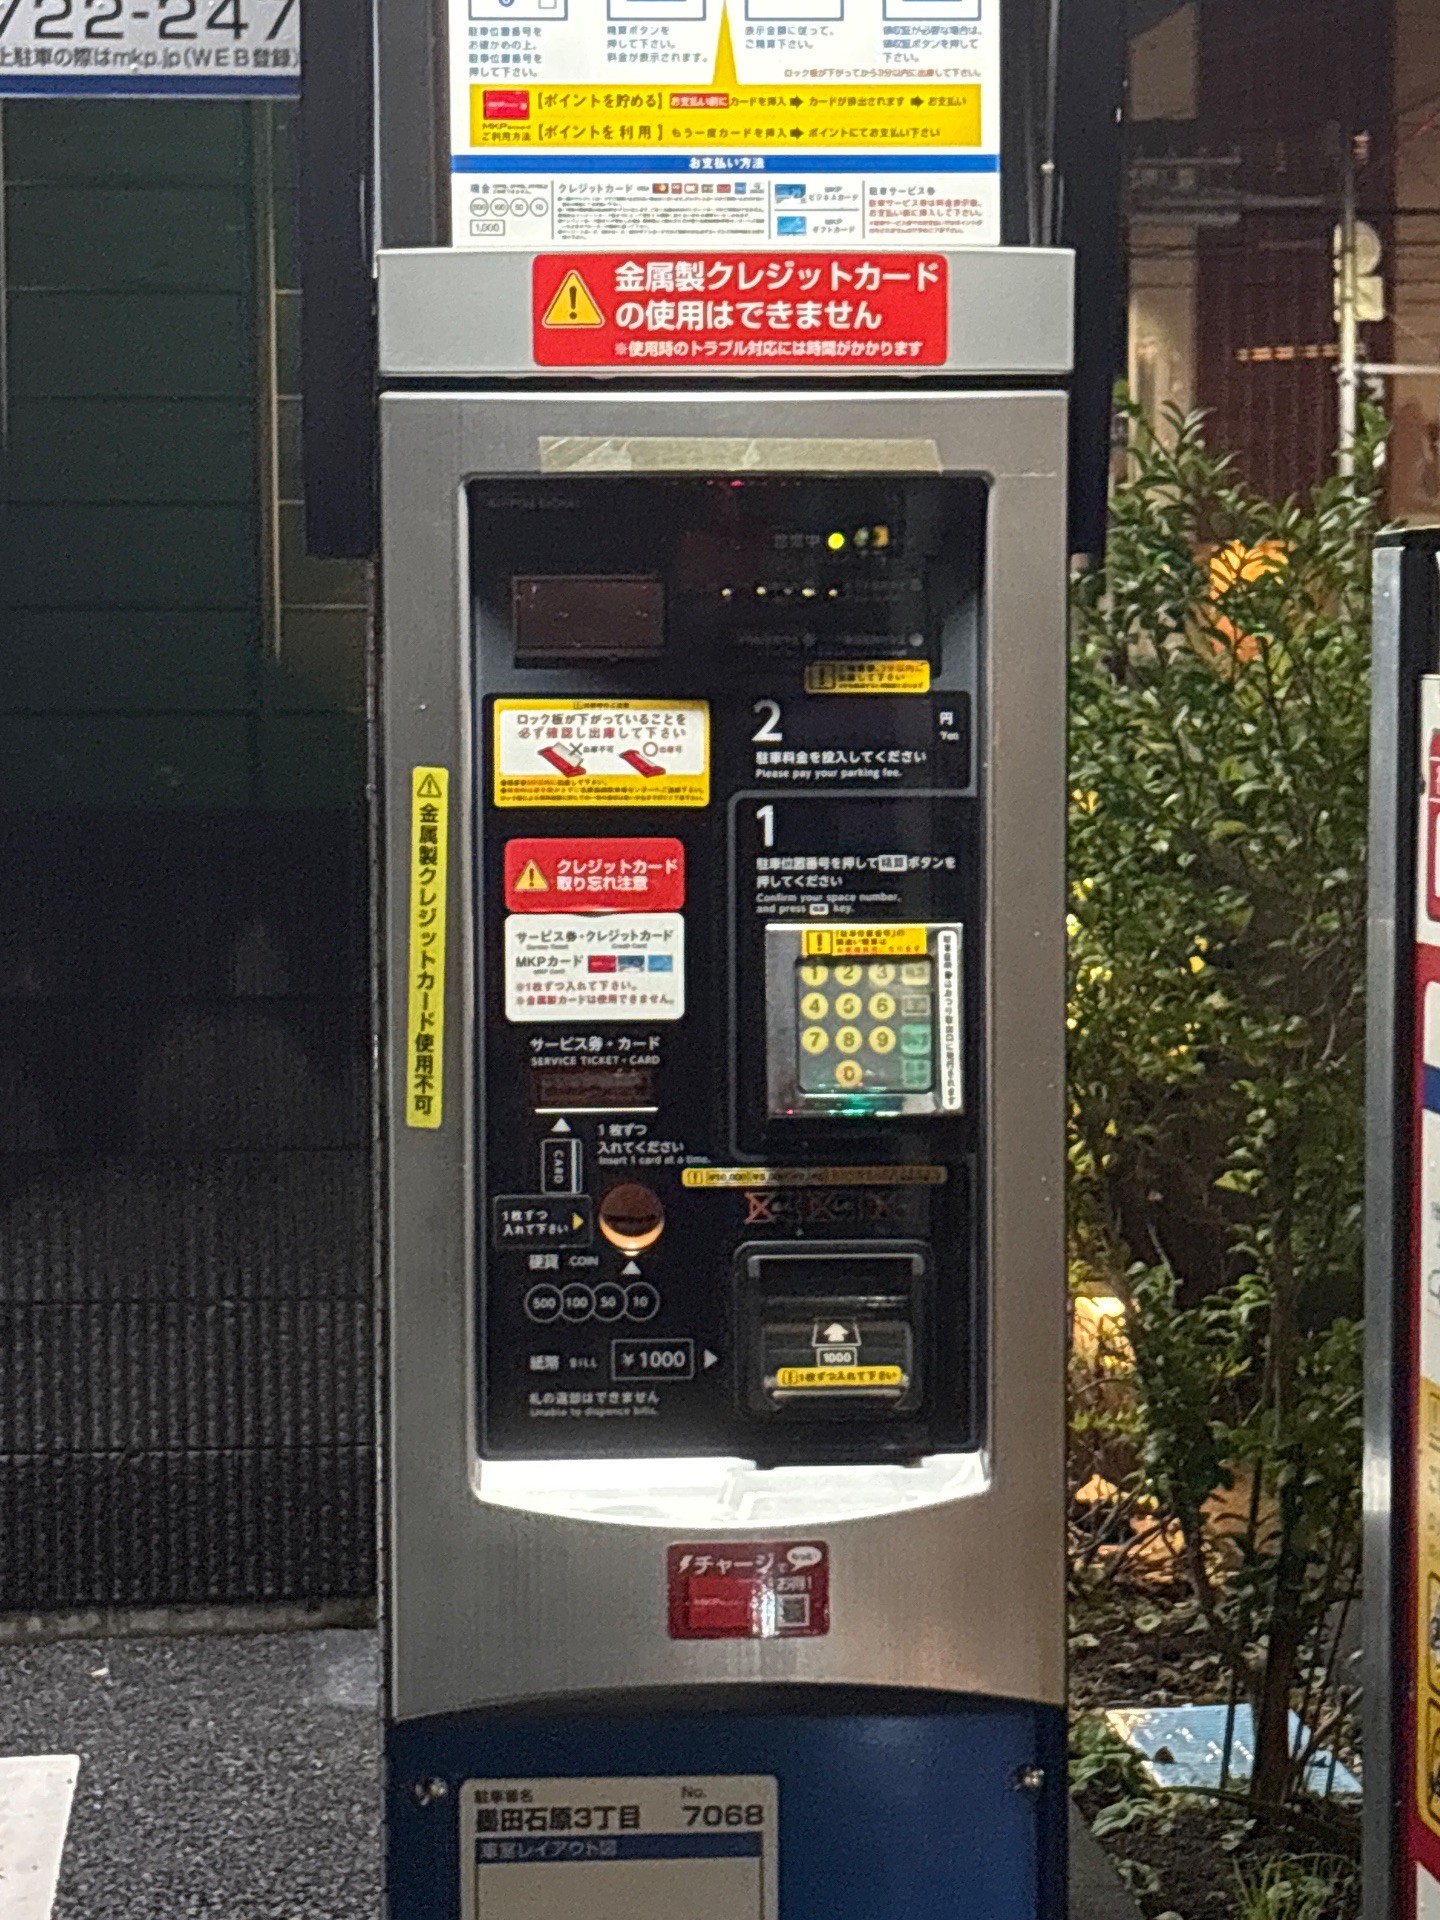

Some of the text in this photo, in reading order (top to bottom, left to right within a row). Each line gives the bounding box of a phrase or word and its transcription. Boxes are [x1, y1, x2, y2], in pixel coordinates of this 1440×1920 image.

[607, 26, 669, 36] 精算ボタンを
[607, 39, 675, 50] 押して下さい。
[745, 39, 814, 49] ご精算下さい。
[607, 52, 708, 63] 料金が表示されます。
[883, 52, 919, 62] 下さい。
[469, 67, 538, 78] 押して下さい。
[688, 156, 765, 170] お支払い方法
[470, 183, 491, 194] 現金
[558, 183, 633, 194] クレジットカード
[812, 225, 856, 234] ギフトカード
[614, 260, 939, 293] 金属製クレジットカード
[615, 300, 882, 331] の使用はできません
[615, 340, 924, 358] ※使用時のトラブル対応には時間がかかります
[516, 713, 687, 726] ロック板が下がっていることを
[752, 700, 783, 742] 2
[940, 711, 954, 726] 円
[518, 727, 687, 740] 必ず確認し出庫して下さい
[940, 731, 960, 741] Yen
[756, 751, 928, 765] 駐車料金を投入してください
[756, 766, 903, 781] Please pay your parking fee.
[756, 805, 774, 847] 1
[557, 859, 679, 875] クレジットカード
[557, 876, 649, 891] 取り忘れ注意
[756, 875, 843, 889] 押してください
[756, 892, 797, 902] Confirm
[801, 893, 824, 904] your
[827, 893, 856, 904] space
[756, 903, 777, 914] and
[779, 904, 807, 916] press
[833, 903, 855, 915] key.
[515, 930, 675, 943] サービス券・クレジットカード
[414, 803, 439, 1116] 金属製クレジットカード使用不可
[515, 954, 584, 968] MKPカード
[810, 964, 819, 980] 1
[843, 964, 855, 980] 2
[876, 963, 889, 980] 3
[515, 981, 638, 992] ※1枚ずつ入れて下さい。
[515, 994, 676, 1006] ※金属製カードは使用できません。
[809, 997, 821, 1014] 4
[842, 997, 855, 1014] 5
[876, 998, 889, 1013] 6
[529, 1035, 662, 1051] サービス券・カード
[809, 1032, 822, 1047] 7
[843, 1031, 855, 1048] 8
[876, 1031, 890, 1048] 9
[530, 1056, 577, 1067] SERVICE
[842, 1065, 856, 1081] 0
[598, 1123, 648, 1137] 1枚ずつ
[597, 1141, 685, 1154] 入れてください
[552, 1150, 565, 1184] CARD
[638, 1155, 662, 1165] card
[664, 1155, 675, 1165] at
[502, 1209, 548, 1221] 1枚ずつ
[503, 1223, 569, 1237] 入れて下さい
[568, 1256, 599, 1267] COIN
[532, 1296, 557, 1310] 500
[567, 1296, 588, 1309] 100
[601, 1296, 617, 1308] 50
[633, 1295, 648, 1308] 10
[569, 1357, 598, 1369] BILL
[823, 1352, 852, 1364] 1000
[681, 1786, 707, 1800] No.
[476, 1804, 641, 1833] 墨田石原3丁目
[682, 1803, 765, 1827] 7068
